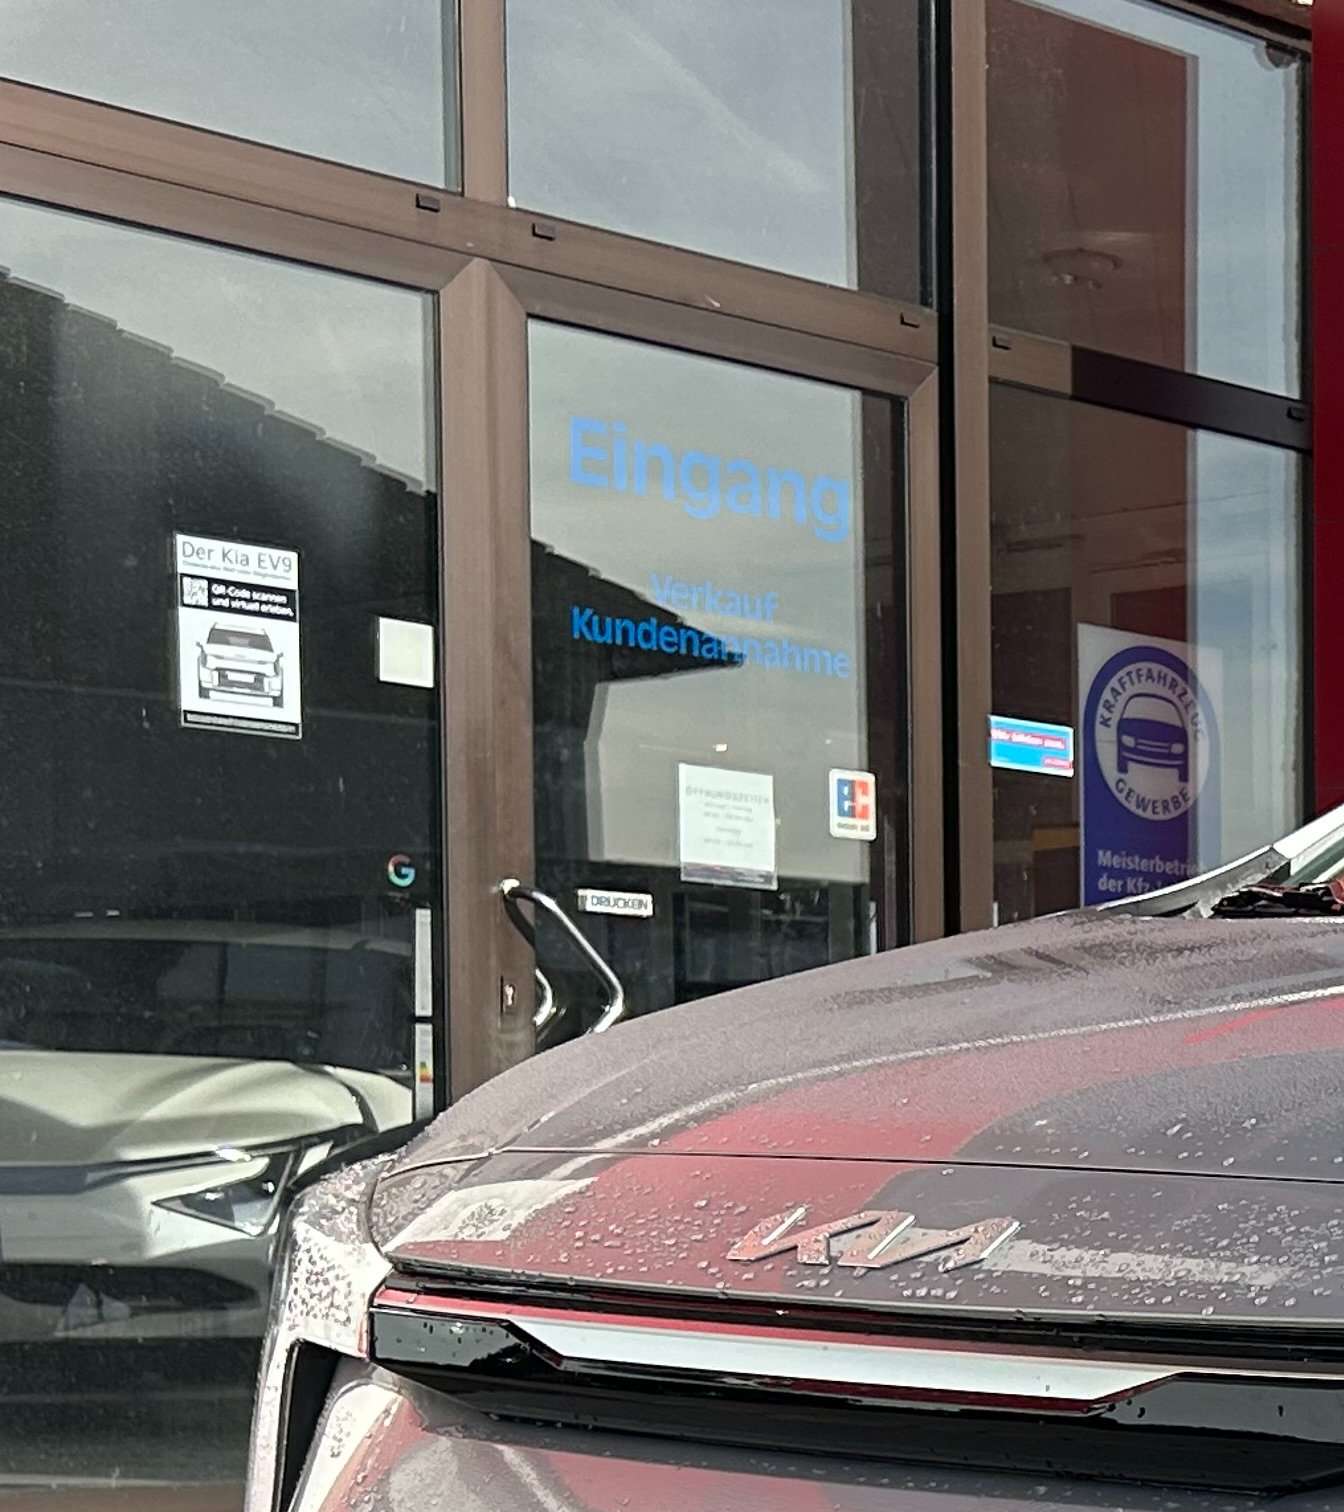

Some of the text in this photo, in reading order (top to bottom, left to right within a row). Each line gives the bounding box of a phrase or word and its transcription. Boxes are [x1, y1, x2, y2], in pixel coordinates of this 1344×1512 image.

[569, 415, 850, 543] Eingang
[182, 541, 215, 561] Der
[222, 546, 250, 567] Kia
[257, 552, 293, 573] EV9
[650, 571, 780, 625] Verkauf
[571, 605, 850, 679] Kundenannahme
[1114, 776, 1191, 816] GEWERBE
[1097, 872, 1123, 893] der
